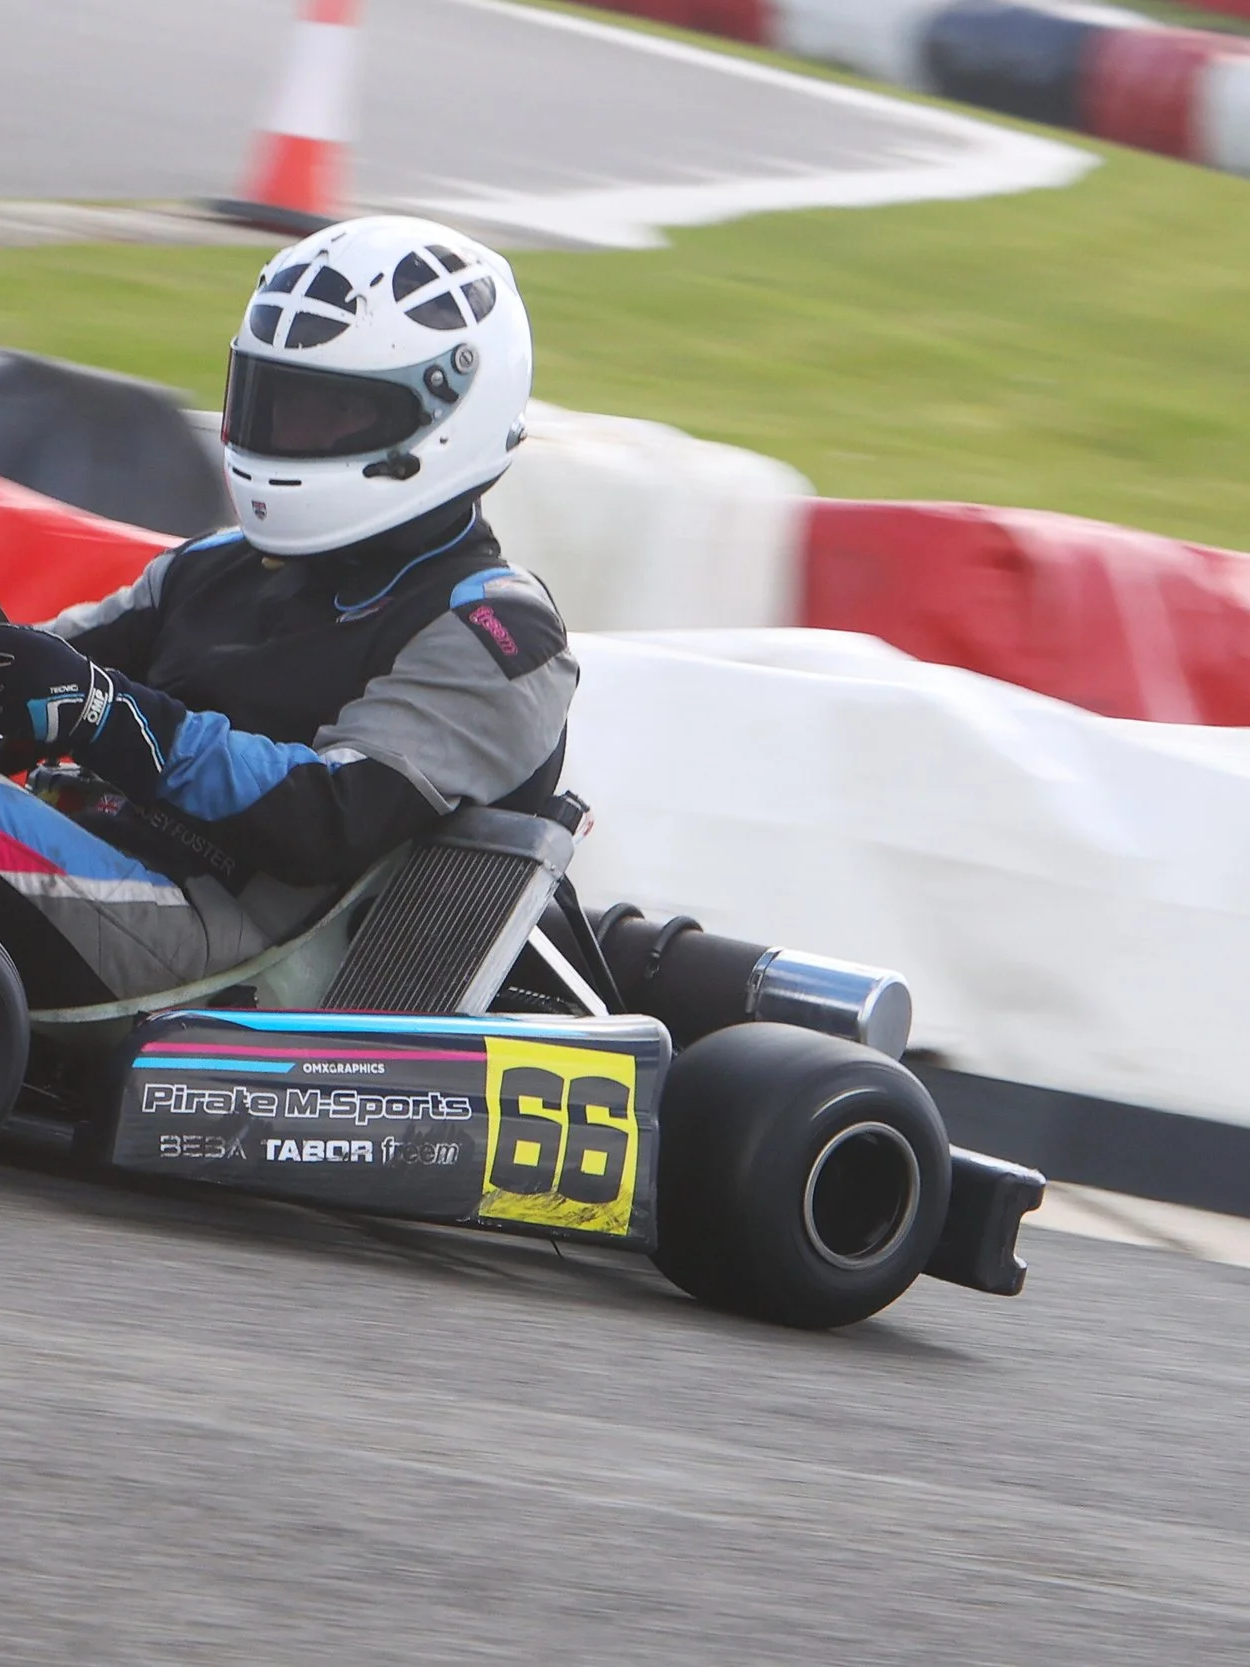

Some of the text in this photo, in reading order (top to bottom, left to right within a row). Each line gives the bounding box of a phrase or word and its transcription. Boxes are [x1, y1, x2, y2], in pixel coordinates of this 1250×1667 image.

[86, 689, 104, 724] OMP
[303, 1062, 385, 1075] OMXGRAPHICS
[142, 1083, 472, 1126] Pirate M-Sports
[265, 1138, 373, 1163] TABOR
[489, 1066, 630, 1204] 66
